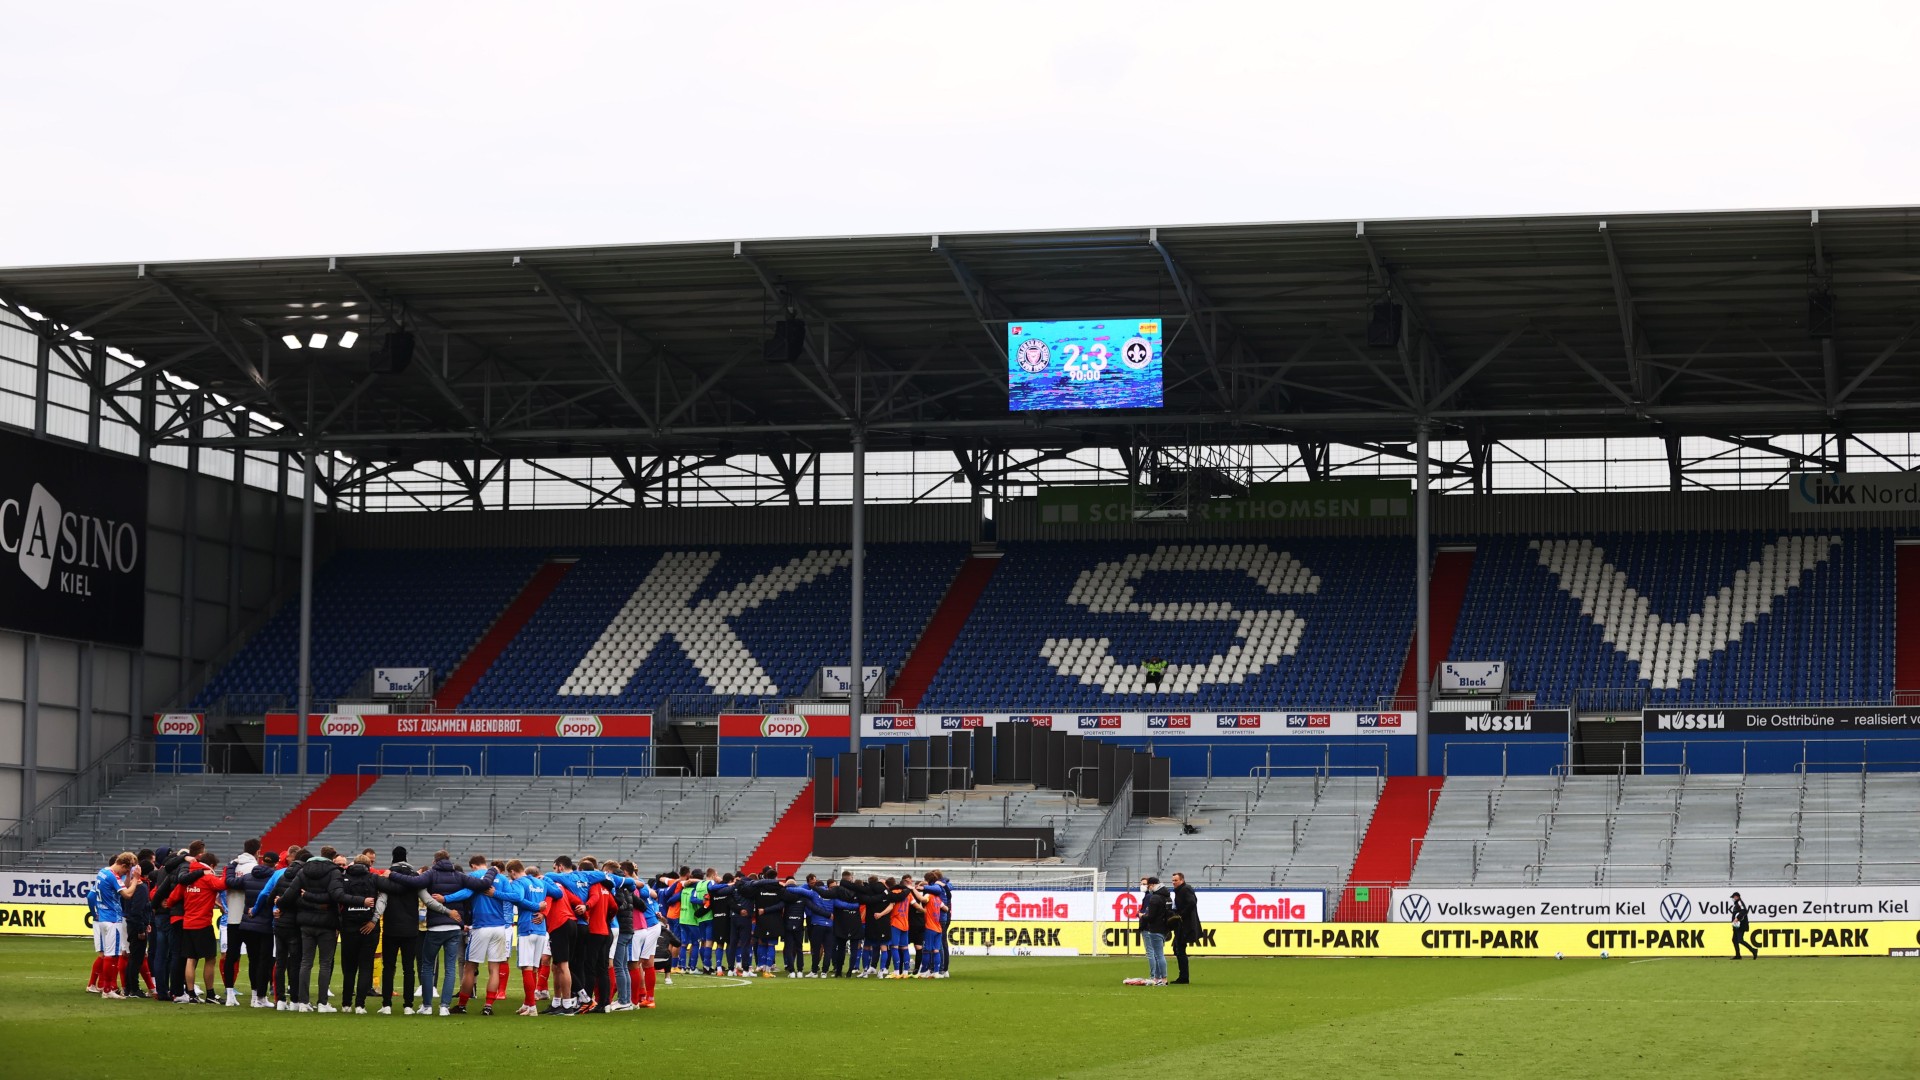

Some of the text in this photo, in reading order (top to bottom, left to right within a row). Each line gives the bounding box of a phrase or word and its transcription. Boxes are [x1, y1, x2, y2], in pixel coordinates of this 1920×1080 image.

[1063, 343, 1108, 371] 2:3
[1069, 370, 1100, 381] 90:00
[0, 498, 138, 573] CASINO
[60, 571, 92, 596] KIEL
[378, 670, 385, 679] P
[826, 669, 833, 678] R
[871, 669, 878, 678] S
[1446, 664, 1453, 674] S
[1492, 664, 1500, 673] T
[389, 682, 413, 691] Block
[1459, 677, 1487, 687] Block
[397, 718, 523, 732] ESST ZUSAMMEN ABENDBROT.
[876, 718, 913, 729] sky bet
[943, 717, 981, 729] sky bet
[1080, 716, 1119, 728] sky bet
[1149, 716, 1189, 728] sky bet
[1218, 716, 1258, 727] sky bet
[1288, 715, 1328, 727] sky bet
[1359, 715, 1399, 727] sky bet
[1746, 714, 1767, 727] Die
[1770, 714, 1835, 727] Osttribüne
[1854, 713, 1907, 726] realisiert
[163, 722, 195, 735] popp
[327, 723, 359, 735] popp
[563, 723, 597, 736] popp
[768, 723, 802, 737] popp
[13, 878, 95, 899] DrückG
[995, 892, 1069, 921] famila
[1230, 893, 1305, 922] famila
[1437, 902, 1536, 919] Volkswagen
[1540, 902, 1611, 915] Zentrum
[1615, 901, 1646, 915] Kiel
[1698, 900, 1798, 919] Volkwagen
[1802, 900, 1873, 915] Zentrum
[1878, 899, 1909, 914] Kiel
[947, 926, 1061, 947] CITTI-PARK
[1262, 928, 1380, 949] CITTI-PARK
[1420, 929, 1540, 949] CITTI-PARK
[1586, 929, 1705, 949] CITTI-PARK
[1750, 928, 1869, 948] CITTI-PARK
